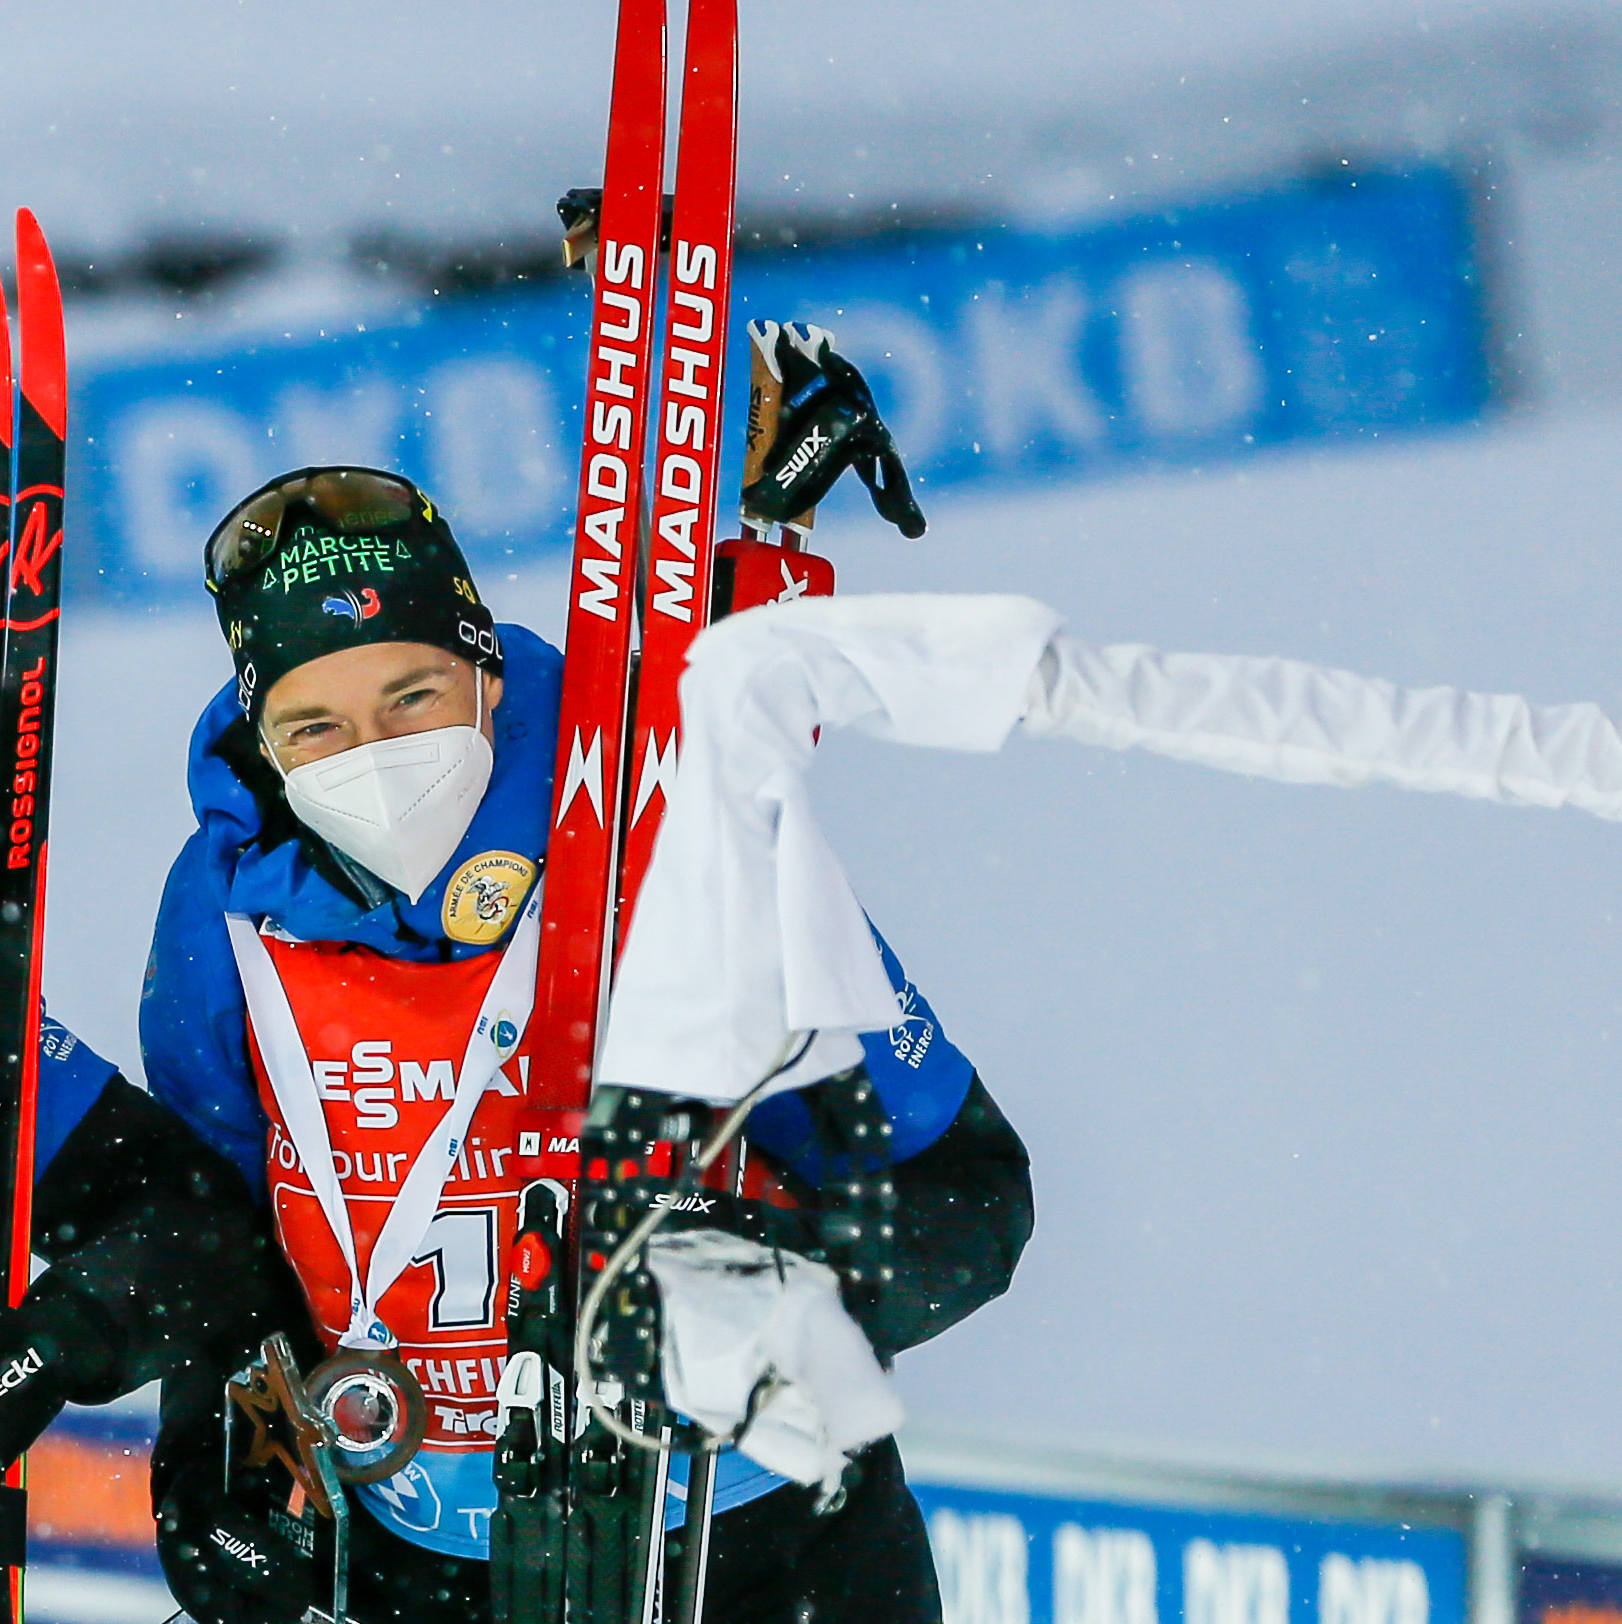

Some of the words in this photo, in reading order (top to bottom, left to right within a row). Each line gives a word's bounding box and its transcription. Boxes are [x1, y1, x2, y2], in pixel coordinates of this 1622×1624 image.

[578, 240, 644, 622] MADSHUS
[652, 242, 718, 625] MADSHUS
[280, 534, 391, 569] MARCEL
[283, 552, 395, 594] PETITE
[8, 657, 45, 869] ROSSIGNOL
[460, 870, 474, 884] DE
[895, 1031, 914, 1061] ROY
[410, 1206, 498, 1332] 1
